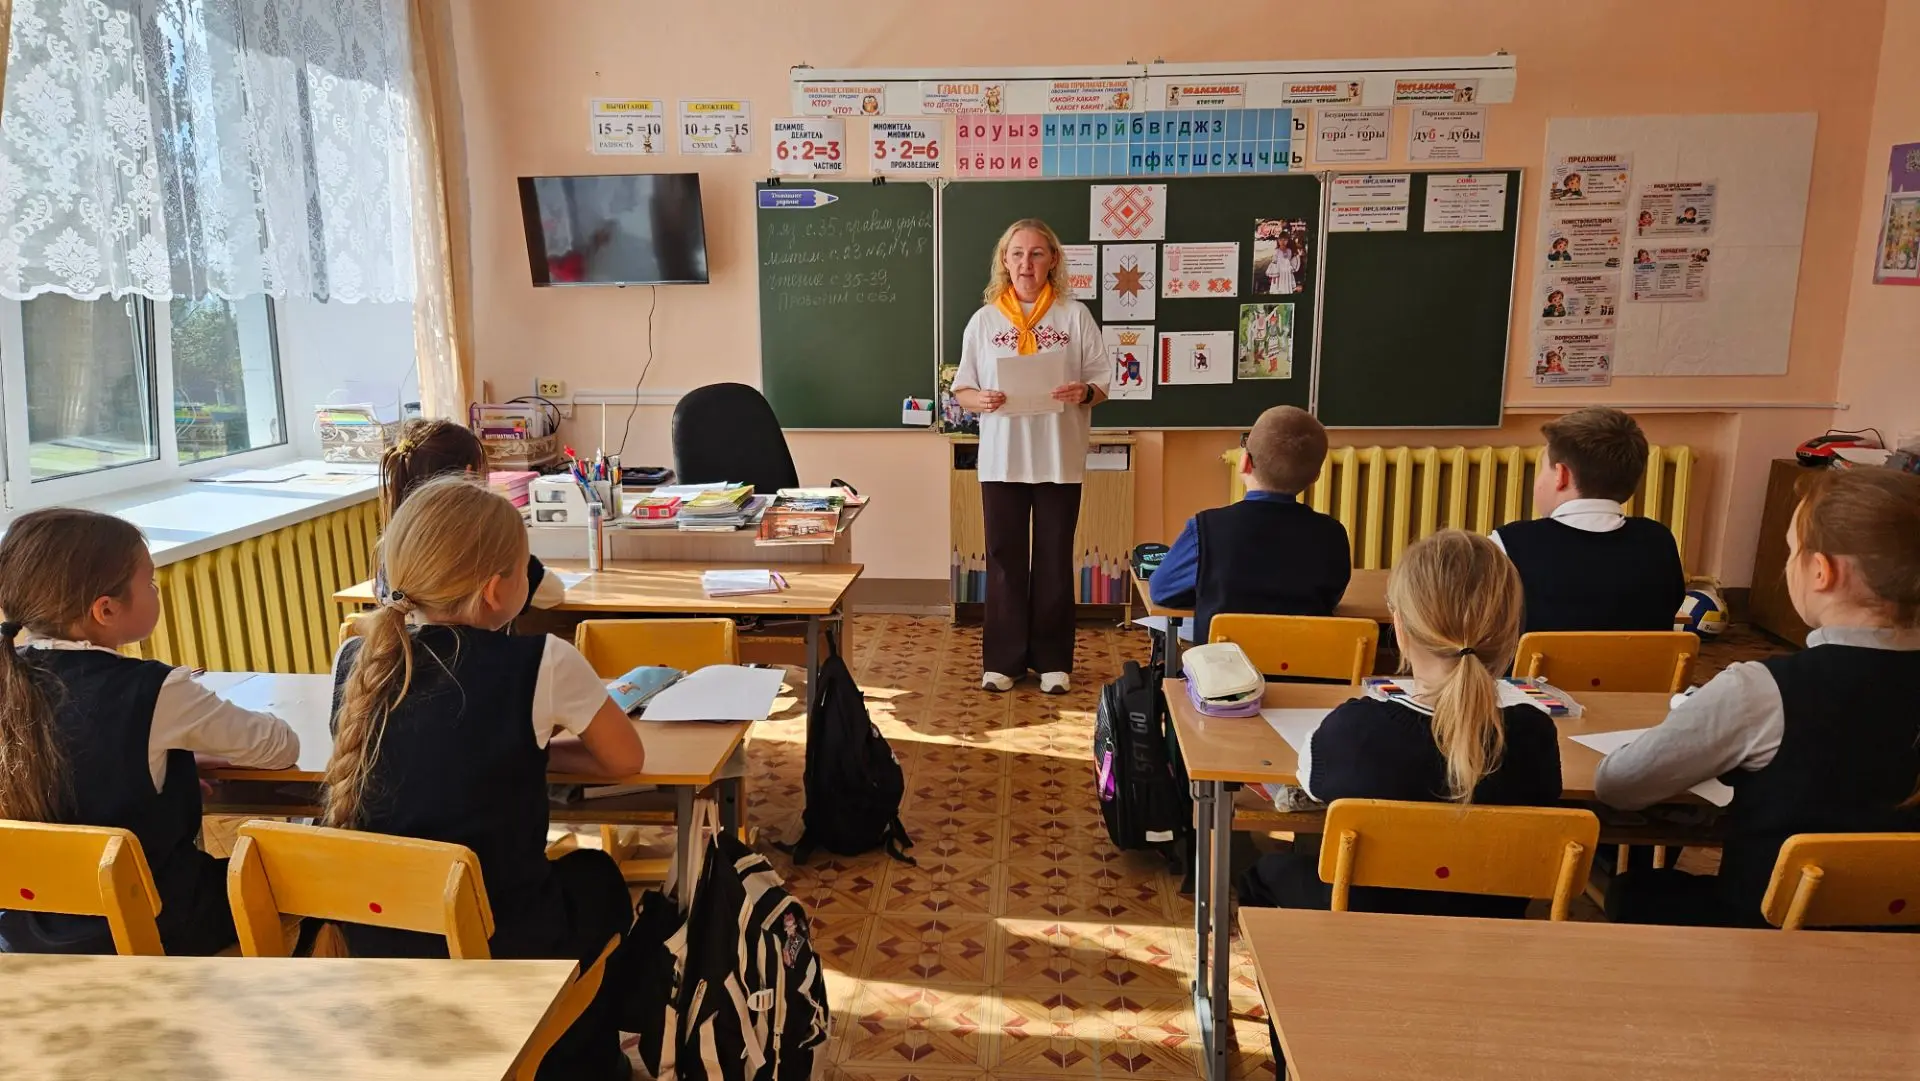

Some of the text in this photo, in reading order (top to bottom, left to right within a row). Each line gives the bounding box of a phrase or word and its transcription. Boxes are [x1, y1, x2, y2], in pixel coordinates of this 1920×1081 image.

[937, 84, 979, 94] ГЛАГОЛ
[598, 123, 612, 135] 15
[626, 123, 634, 135] 5
[684, 123, 698, 135] 10
[714, 123, 722, 135] 5
[774, 123, 804, 131] ДЕЛИМОЕ
[873, 123, 912, 131] МНОЖИТЕЛЬ
[959, 126, 968, 137] а
[975, 126, 985, 138] о
[992, 126, 1002, 141] у
[1009, 126, 1023, 137] ы
[1029, 125, 1039, 136] э
[1045, 125, 1055, 136] н
[1062, 126, 1074, 136] м
[1079, 125, 1090, 136] л
[1097, 125, 1107, 139] р
[1115, 120, 1124, 135] й
[1132, 118, 1143, 133] б
[1150, 122, 1160, 133] в
[1167, 121, 1174, 133] г
[1179, 121, 1190, 136] д
[1194, 120, 1208, 133] ж
[1213, 120, 1222, 133] з
[791, 131, 823, 139] ДЕЛИТЕЛЬ
[887, 131, 926, 139] МНОЖИТЕЛЬ
[1413, 128, 1436, 143] дуб
[1447, 128, 1480, 143] дубы
[890, 161, 940, 169] ПРОИЗВЕДЕНИЕ
[959, 157, 968, 169] я
[975, 153, 984, 169] ё
[990, 157, 1005, 169] ю
[1011, 157, 1021, 168] и
[1029, 156, 1038, 168] е
[1132, 155, 1141, 167] п
[1145, 151, 1160, 171] ф
[1165, 155, 1174, 166] к
[1178, 154, 1188, 166] т
[1193, 154, 1207, 166] ш
[1212, 154, 1221, 165] с
[1228, 153, 1237, 165] х
[1242, 152, 1253, 167] ц
[1259, 152, 1268, 164] ч
[1273, 151, 1289, 166] щ
[814, 162, 842, 170] ЧАСТНОЕ
